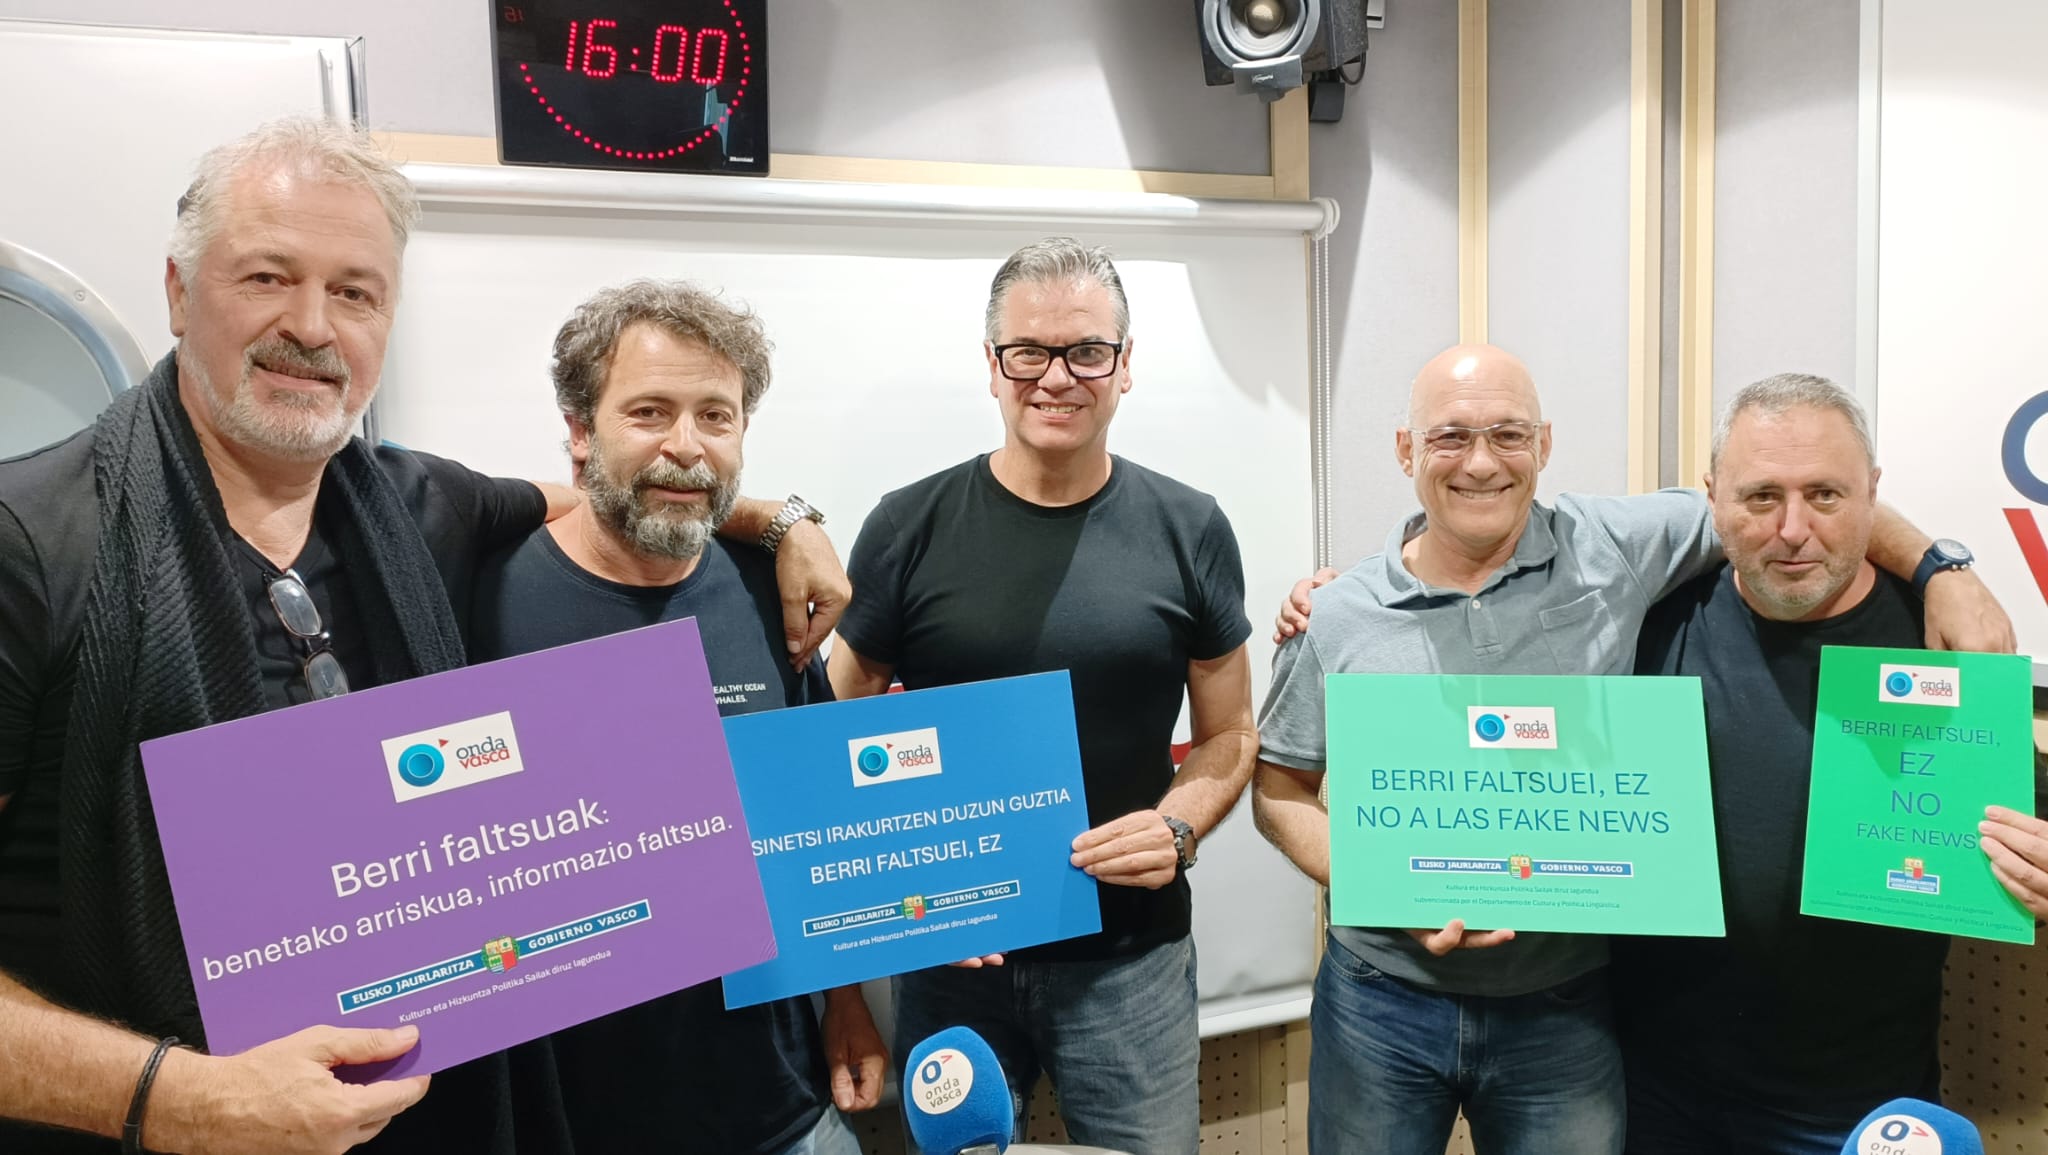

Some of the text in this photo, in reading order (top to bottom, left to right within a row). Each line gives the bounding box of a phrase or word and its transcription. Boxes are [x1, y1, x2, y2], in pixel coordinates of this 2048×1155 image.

[565, 19, 728, 84] 16:00
[1920, 680, 1951, 689] onda
[1921, 687, 1952, 697] vasca
[1514, 720, 1547, 732] onda
[1515, 730, 1549, 739] vasca
[1841, 719, 2000, 746] BERRI FALTSUEI,
[456, 736, 507, 759] onda
[459, 748, 510, 769] vasca
[897, 744, 931, 760] onda
[899, 755, 933, 768] vasca
[1900, 751, 1936, 776] EZ
[1372, 769, 1650, 798] BERRI FALTSUEI, EZ
[1891, 790, 1941, 816] NO
[752, 788, 1071, 856] SINETSI IRAKURTZEN DUZUN GUZTIA
[1357, 805, 1670, 833] NO A LAS FAKE NEWS
[331, 798, 609, 897] Berri faltsuak:
[1857, 823, 1977, 849] FAKE NEWS
[811, 834, 1002, 884] BERRI FALTSUEI, EZ
[1418, 860, 1623, 872] EUSKO JAURLARITZA GOBIERNO VASCO
[203, 815, 733, 980] benetako arriskua, informazio faltsua.
[812, 886, 1010, 931] EUSKO JAURLARITZA GOBIERNO VASCO
[833, 913, 998, 951] Kultura eta Hizkuntza Politika Sailak diruz lagundua
[352, 909, 638, 1004] EUSKO JAURLARITZA GOBIERNO VASCO
[399, 950, 611, 1023] Kultura eta Hizkuntza Politika Sailak diruz lagundua
[926, 1078, 960, 1099] onda
[930, 1088, 961, 1108] vasca
